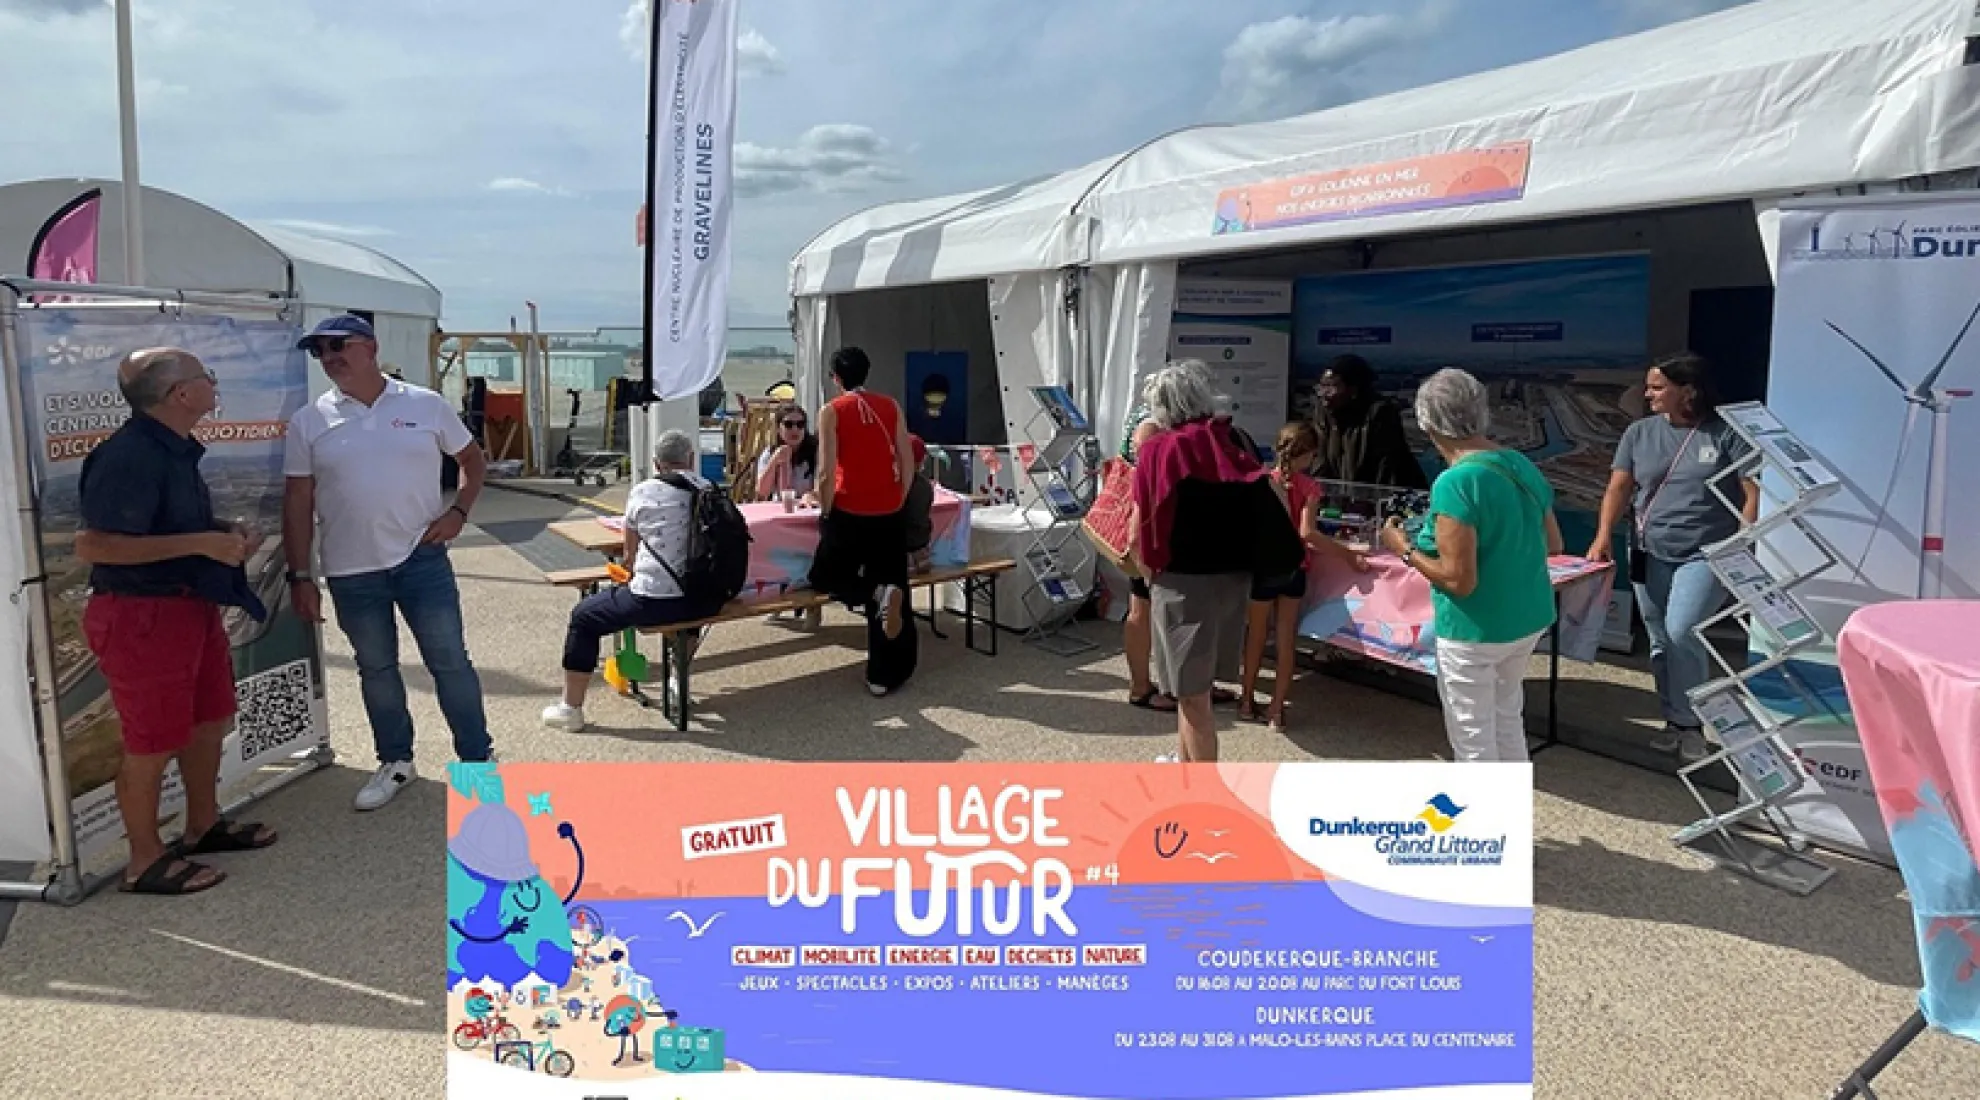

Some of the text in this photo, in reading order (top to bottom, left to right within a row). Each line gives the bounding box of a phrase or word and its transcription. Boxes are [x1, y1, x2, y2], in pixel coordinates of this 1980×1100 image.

[673, 126, 685, 204] PRODUCTION
[694, 123, 714, 261] GRAVELINES
[672, 207, 683, 225] DE
[670, 298, 681, 343] CENTRE
